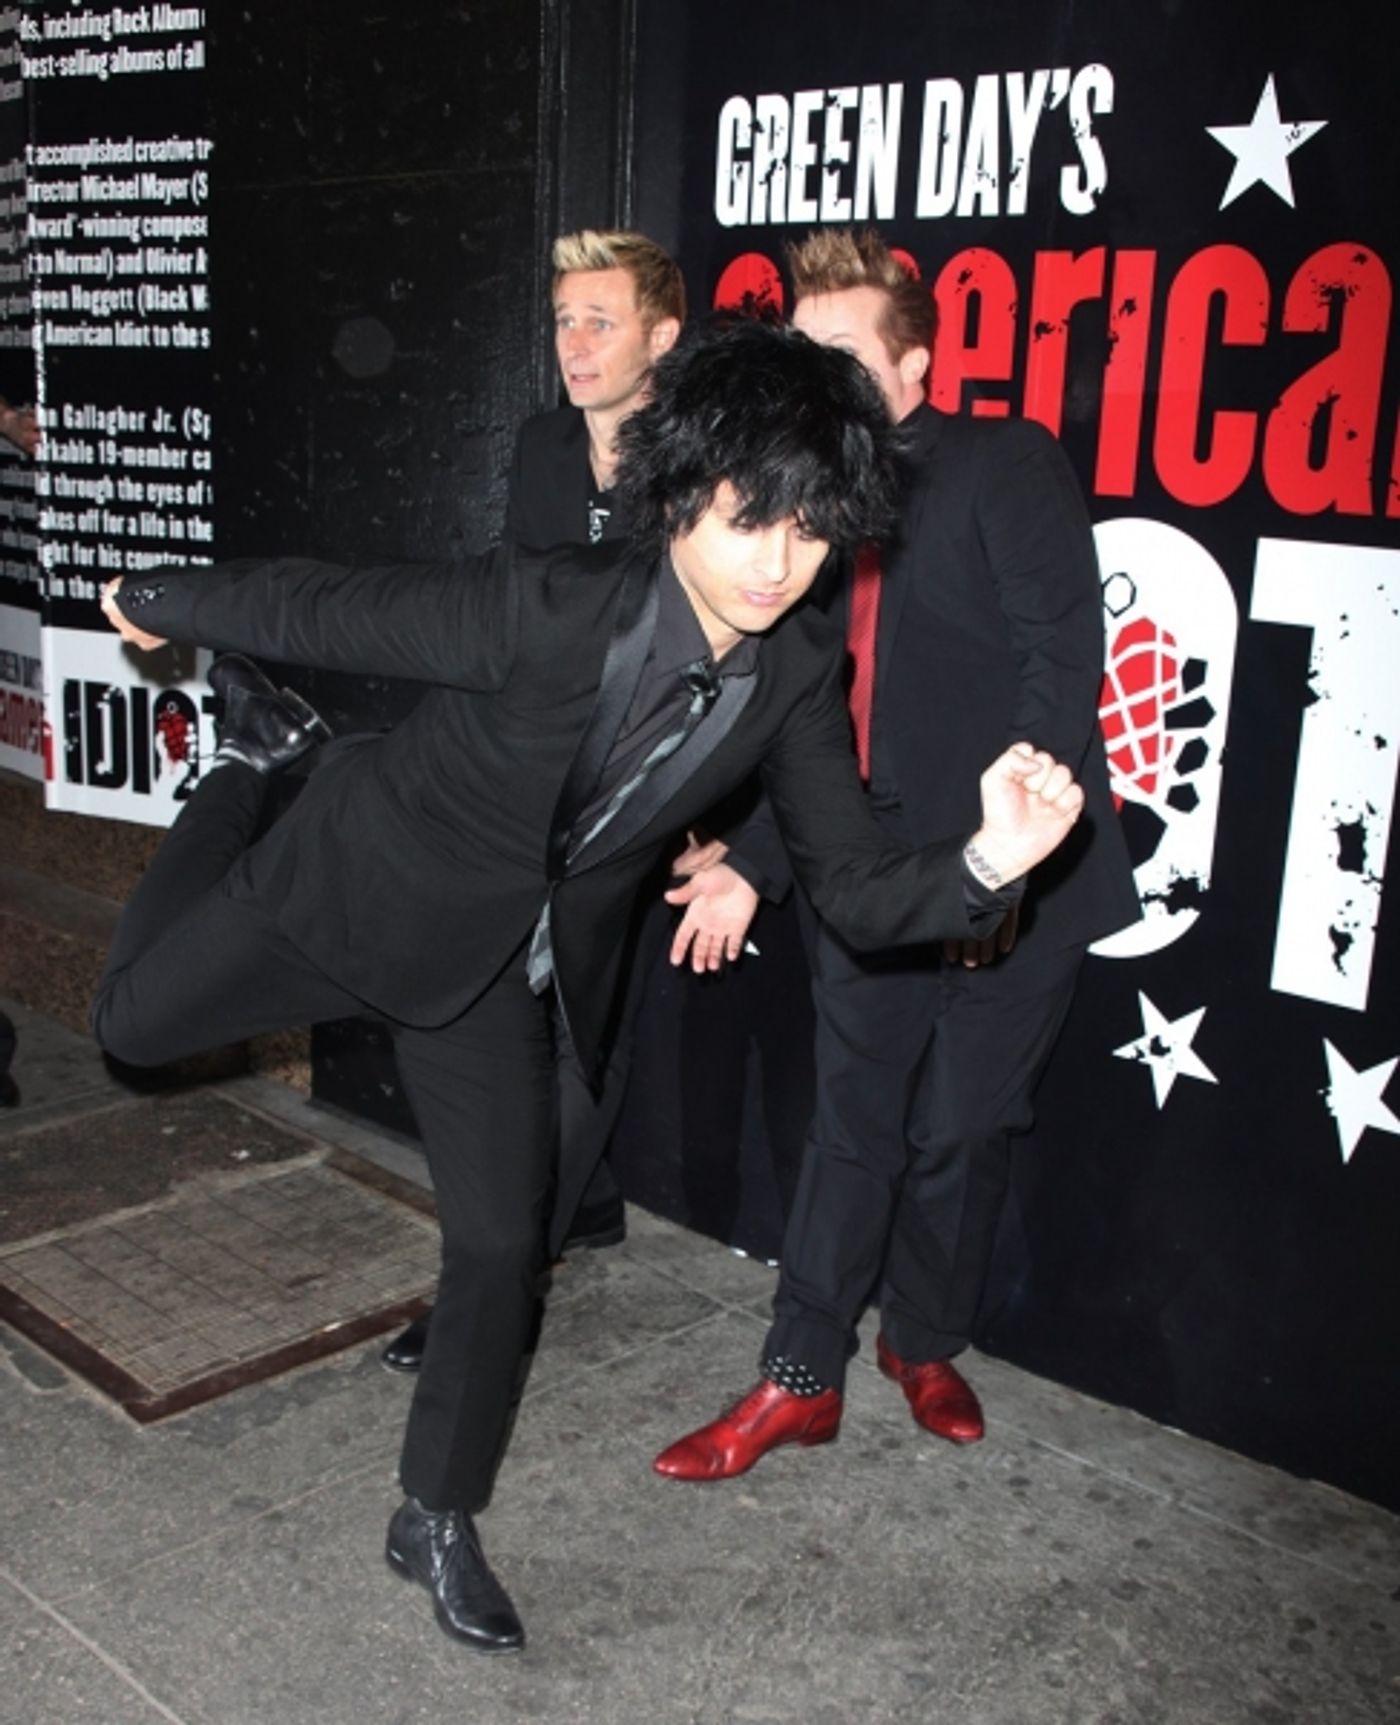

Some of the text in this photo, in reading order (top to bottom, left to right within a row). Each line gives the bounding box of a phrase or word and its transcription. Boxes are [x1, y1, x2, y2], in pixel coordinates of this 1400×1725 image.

[43, 8, 112, 43] including
[112, 6, 151, 36] Rock
[151, 3, 200, 32] Album
[109, 44, 165, 74] albums
[166, 40, 184, 71] of
[184, 38, 205, 71] all
[36, 135, 134, 171] accomplished
[135, 134, 194, 163] creative
[714, 63, 1115, 228] GREEN DAY'S
[80, 174, 140, 202] Michael
[140, 172, 189, 206] Mayer
[54, 247, 114, 282] Normal)
[115, 247, 145, 276] and
[146, 246, 194, 276] Olivier
[71, 284, 134, 318] Hoggett
[136, 282, 189, 318] (Black
[45, 318, 113, 349] American
[114, 319, 151, 349] Idiot
[152, 324, 170, 349] to
[171, 320, 198, 350] the
[62, 402, 147, 436] Gallagher
[151, 405, 177, 434] Jr.
[97, 438, 189, 470] 19-member
[191, 449, 212, 472] ca
[54, 472, 115, 506] through
[117, 474, 146, 503] the
[147, 481, 186, 511] eyes
[187, 478, 205, 507] of
[77, 507, 100, 534] off
[102, 507, 126, 537] for
[127, 516, 138, 537] a
[139, 510, 168, 541] life
[169, 512, 187, 542] in
[187, 513, 214, 544] the
[71, 540, 98, 568] for
[98, 542, 123, 569] his
[68, 574, 97, 602] the
